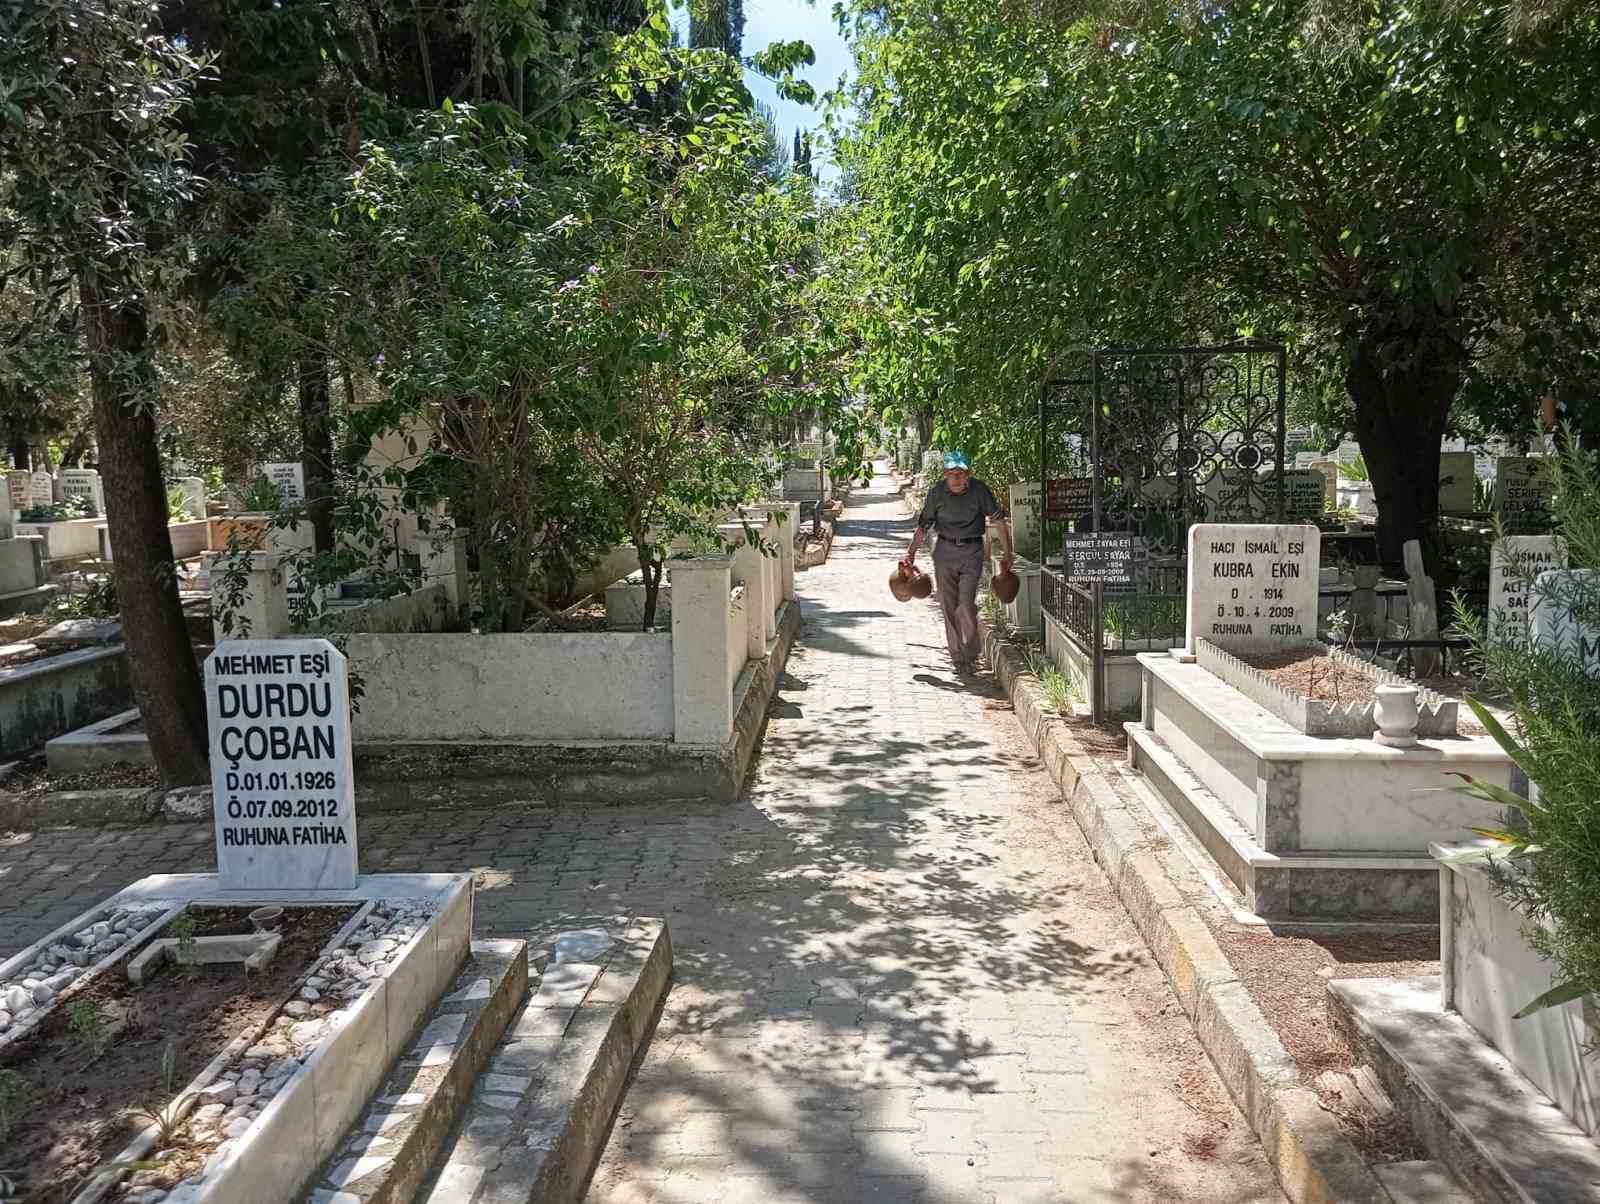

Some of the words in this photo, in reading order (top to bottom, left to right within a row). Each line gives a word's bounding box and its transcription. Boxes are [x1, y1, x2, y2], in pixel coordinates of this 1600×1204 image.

[1103, 550, 1131, 560] SAYAR
[1210, 542, 1235, 554] HACI
[1245, 540, 1279, 554] İSMAİL
[1288, 541, 1304, 556] EŞİ
[1213, 562, 1254, 578] KUBRA
[1271, 560, 1300, 578] EKİN
[1264, 588, 1283, 600] 1914
[1212, 624, 1253, 635] RUHUNA
[1270, 622, 1303, 637] FATİHA
[214, 654, 295, 676] MEHMET
[300, 650, 330, 678] EŞİ
[218, 682, 332, 719] DURDU
[220, 725, 336, 770] ÇOBAN
[226, 772, 336, 791] D.01.01.1926
[228, 796, 338, 818] Ö.07.09.2012
[223, 828, 290, 846] RUHUNA
[292, 822, 347, 845] FATİHA
